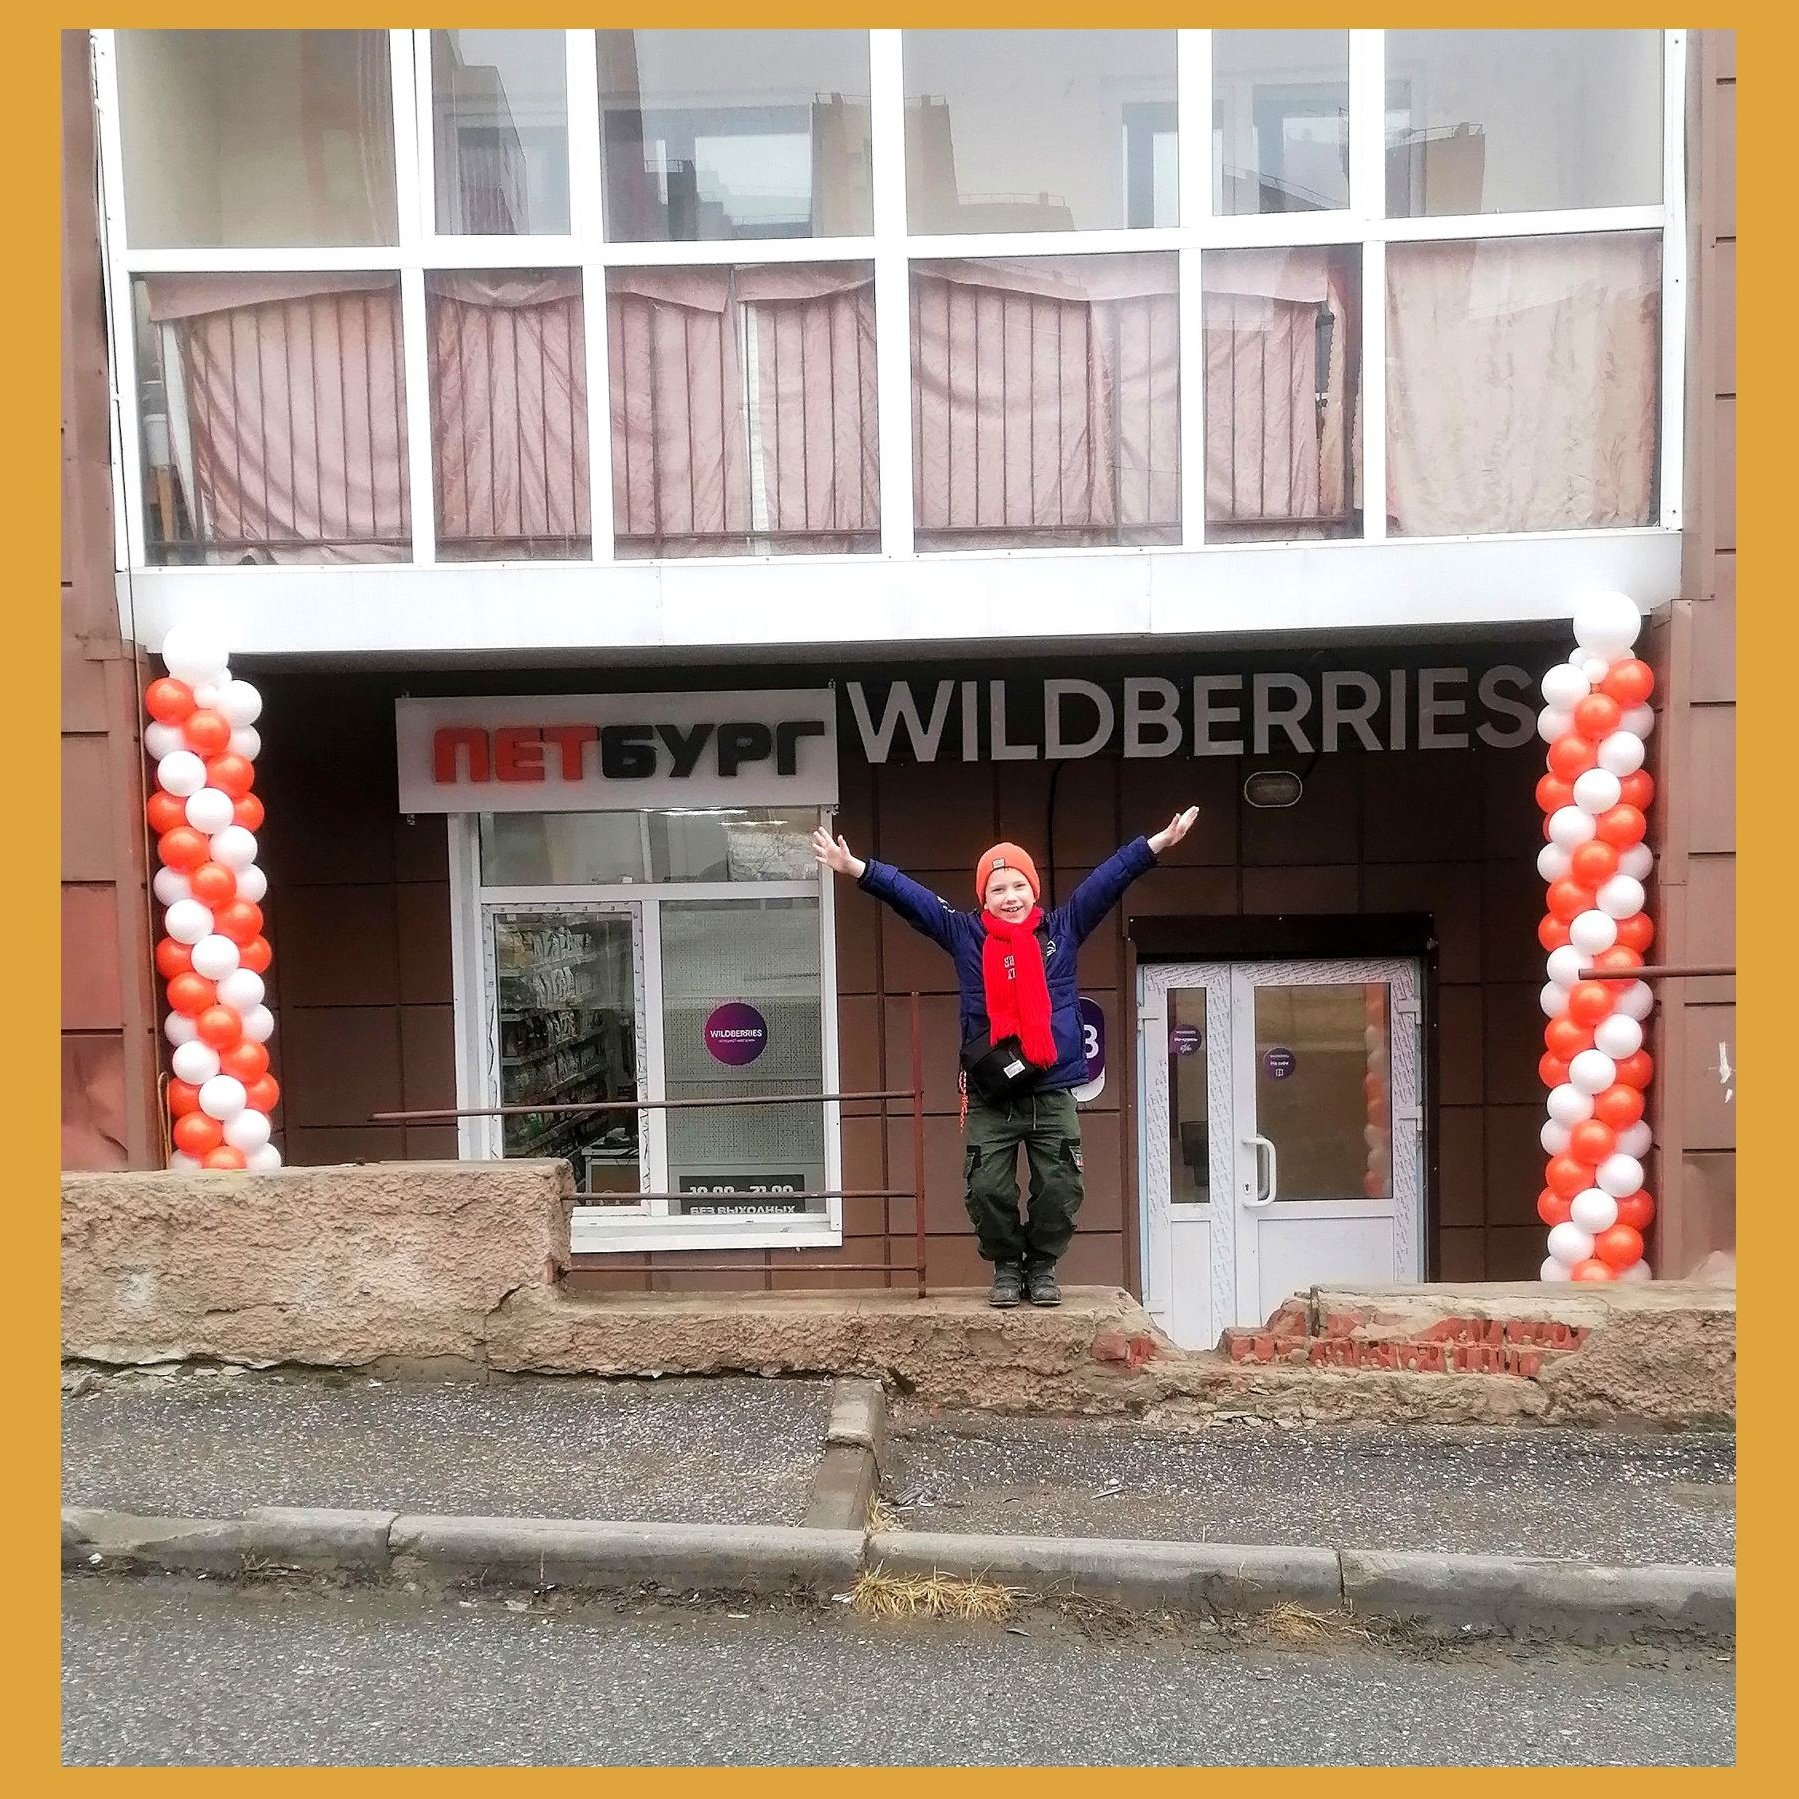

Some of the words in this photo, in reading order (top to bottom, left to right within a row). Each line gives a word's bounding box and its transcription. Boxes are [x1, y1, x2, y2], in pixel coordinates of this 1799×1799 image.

[846, 665, 1537, 763] WILDBERRIES
[433, 720, 825, 783] ПЕТБУРГ
[710, 1029, 763, 1038] WILDBERRIES
